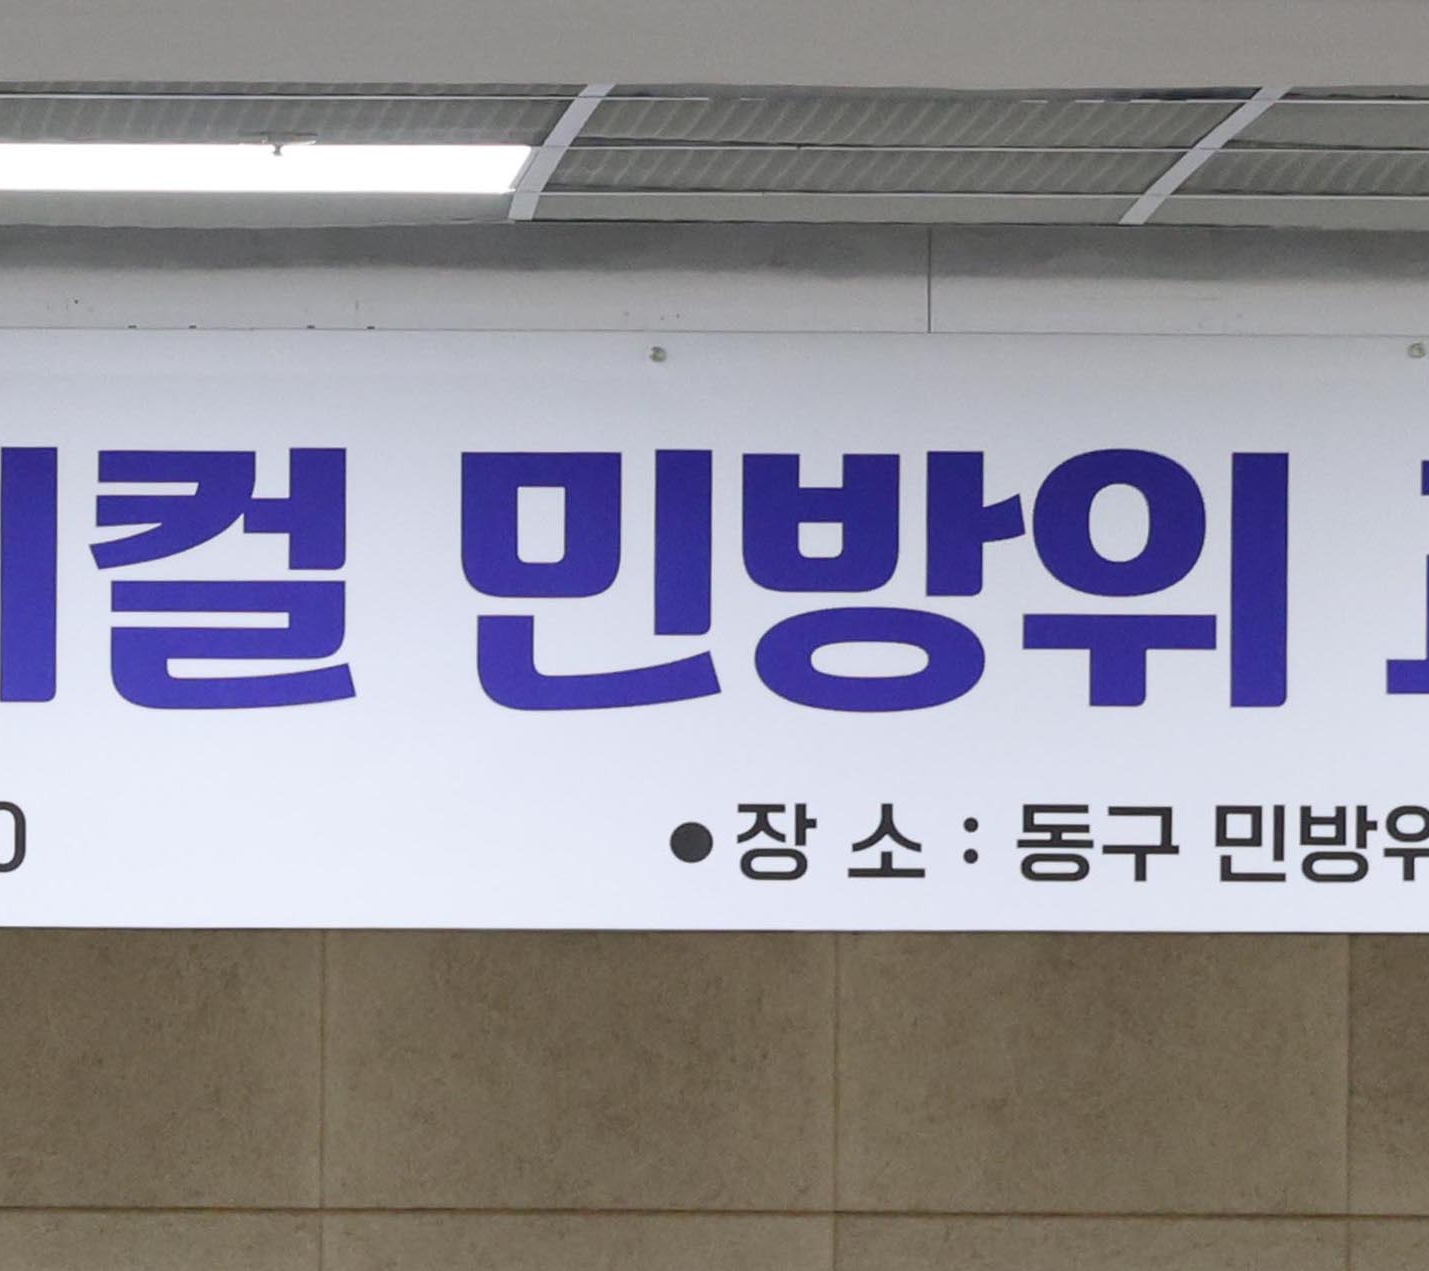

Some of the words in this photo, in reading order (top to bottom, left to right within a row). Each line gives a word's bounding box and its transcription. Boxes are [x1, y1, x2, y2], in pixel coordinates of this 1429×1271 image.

[461, 448, 1290, 713] 민방위
[737, 803, 817, 881] 장
[1016, 804, 1180, 882] 동구
